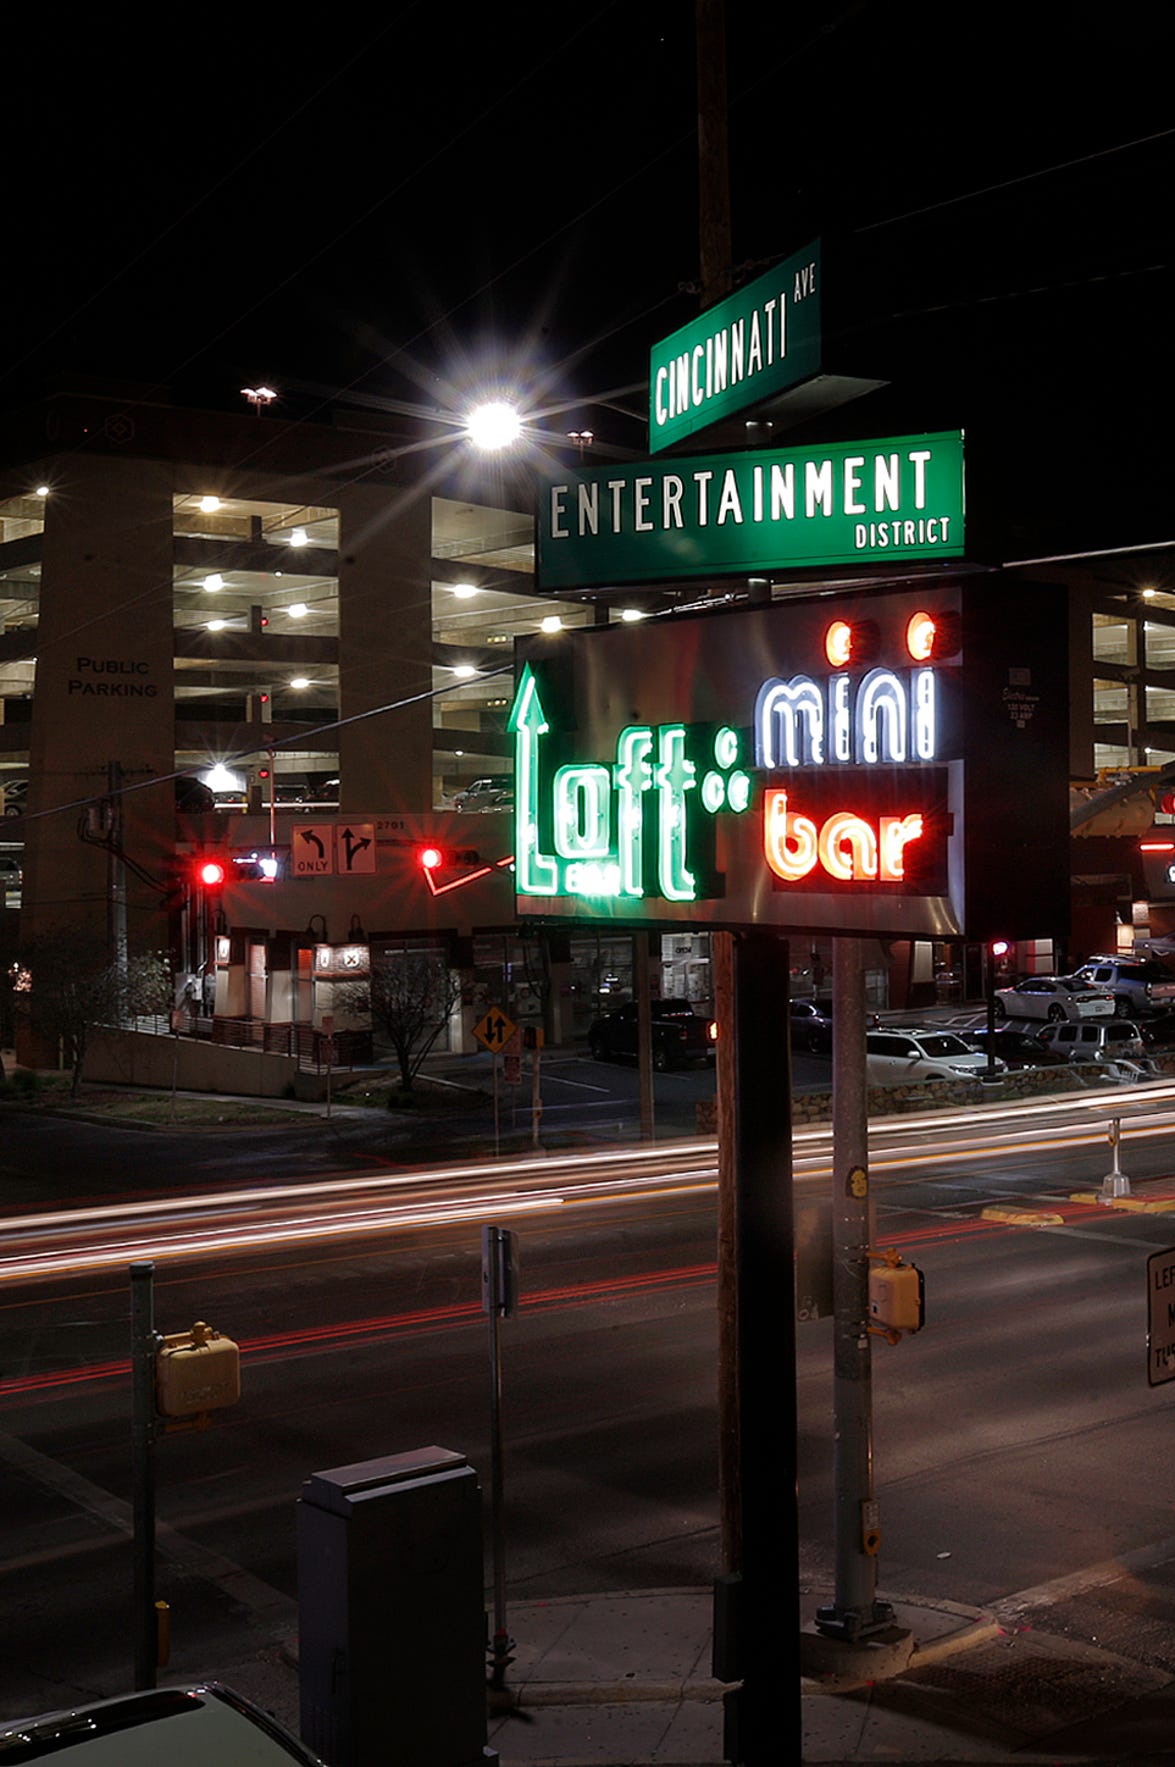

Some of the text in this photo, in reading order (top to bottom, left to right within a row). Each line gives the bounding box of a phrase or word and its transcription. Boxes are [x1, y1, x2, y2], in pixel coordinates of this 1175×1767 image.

[655, 262, 816, 427] CINCINNATI AVE
[551, 450, 932, 539] ENTERTAINMENT
[854, 516, 951, 549] DISTRICT
[68, 679, 157, 698] PARKING
[76, 657, 149, 674] PUBLIC
[754, 611, 937, 769] mini
[508, 661, 696, 901] Loft
[298, 861, 328, 872] ONLY
[763, 787, 923, 882] bar
